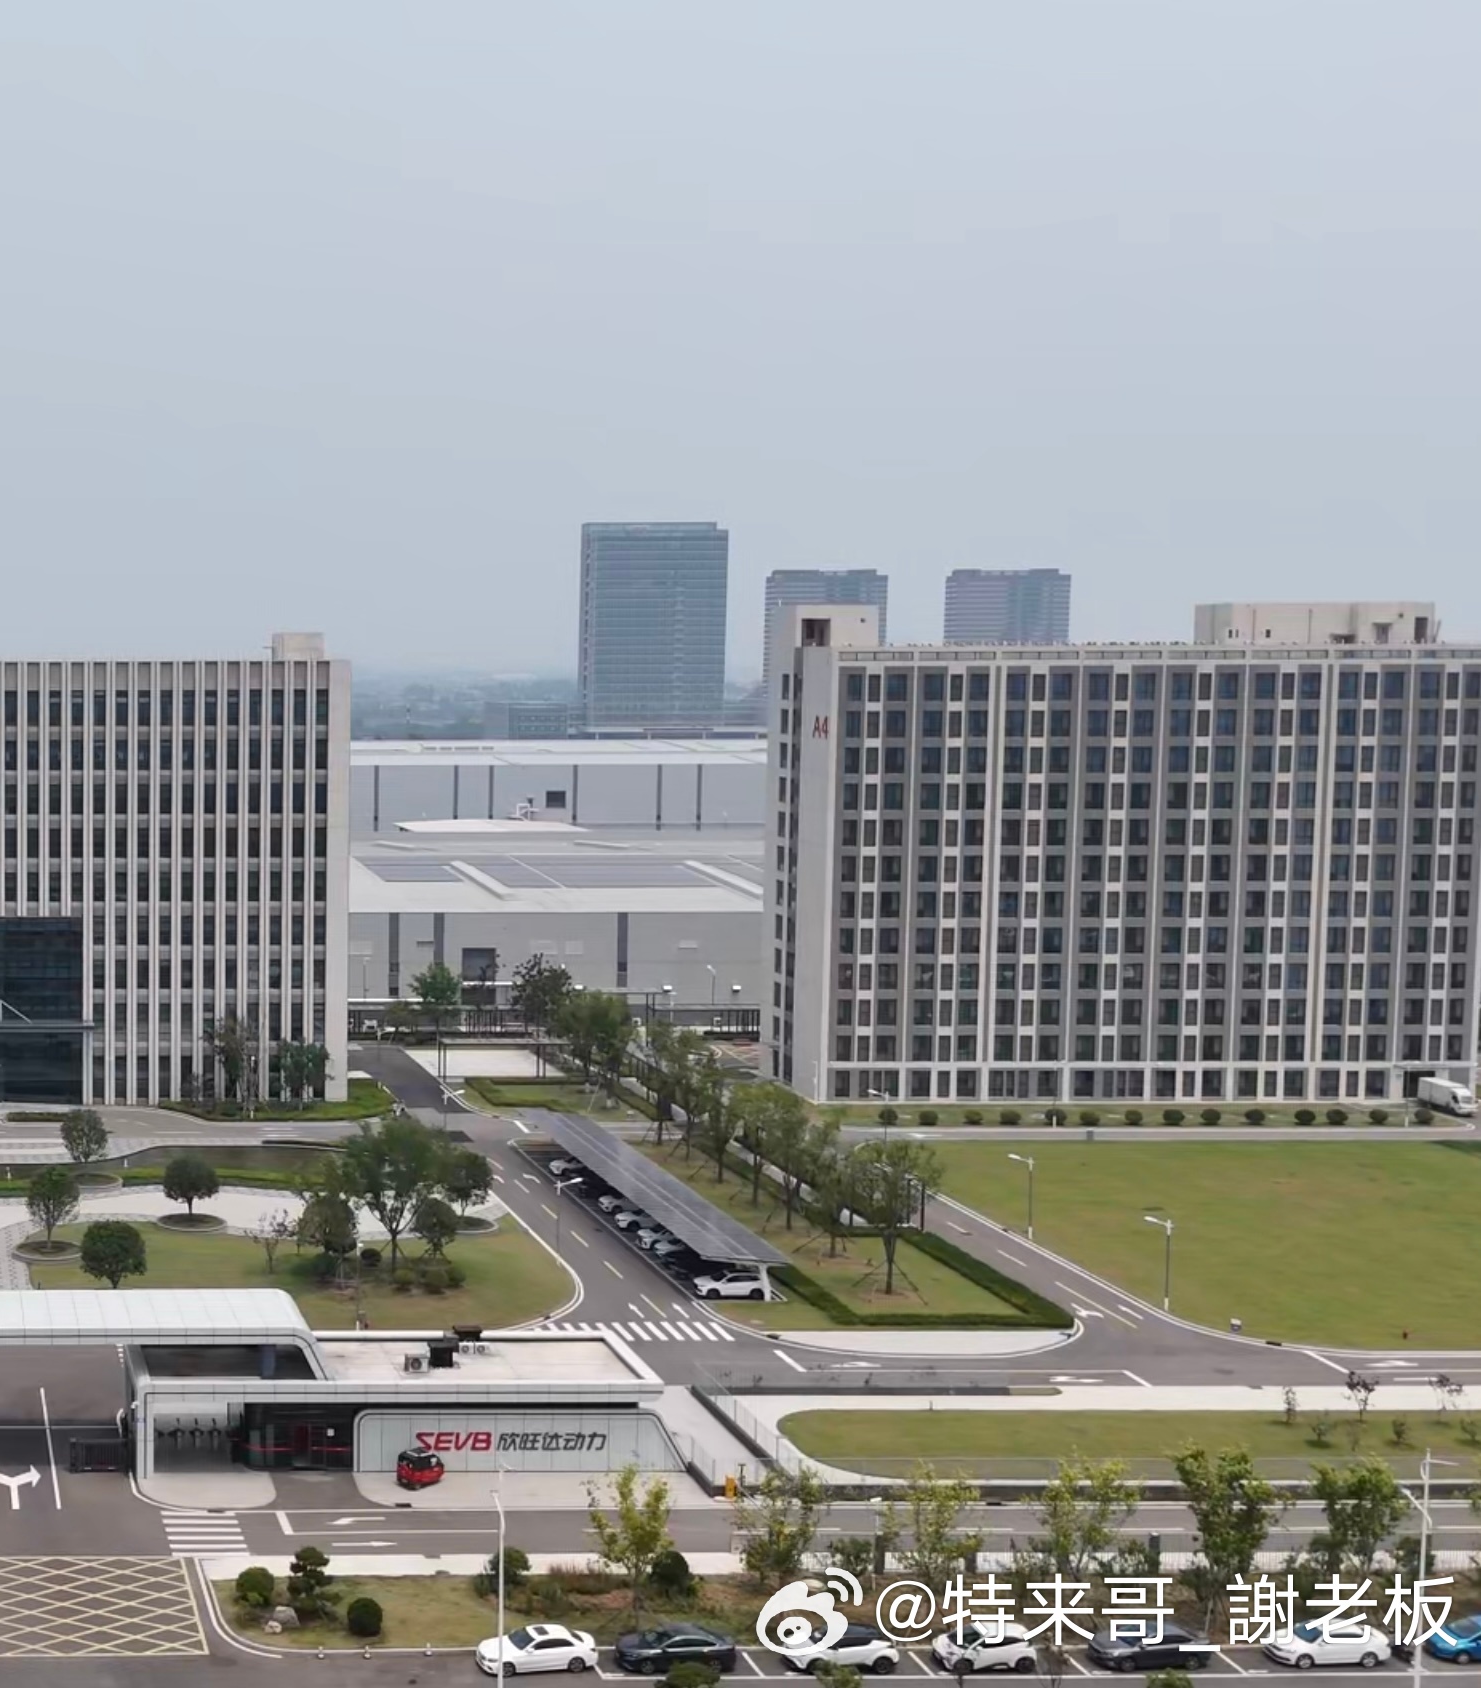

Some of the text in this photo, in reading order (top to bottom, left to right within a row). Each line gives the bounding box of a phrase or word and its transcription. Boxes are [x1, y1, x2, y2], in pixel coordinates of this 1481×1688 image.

[812, 715, 830, 740] A4
[416, 1431, 607, 1451] SEVB 欣旺达动力
